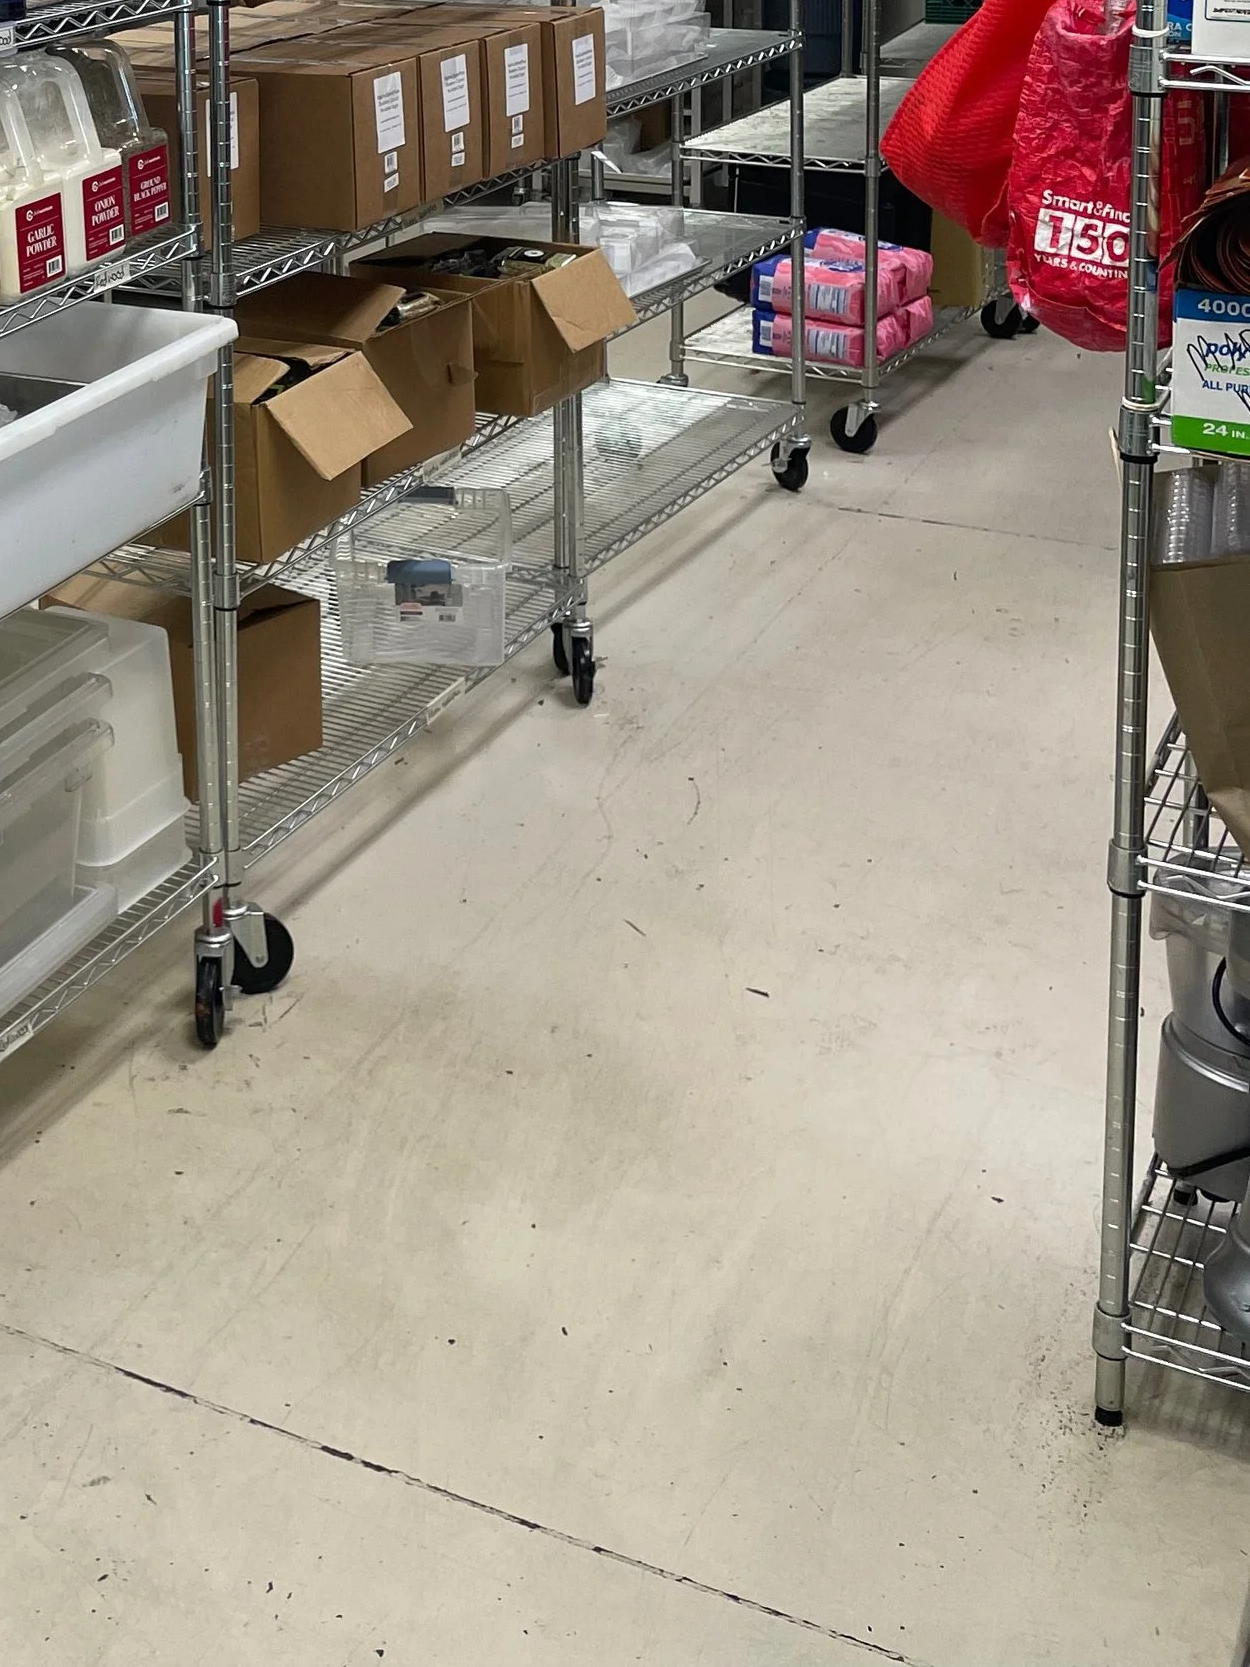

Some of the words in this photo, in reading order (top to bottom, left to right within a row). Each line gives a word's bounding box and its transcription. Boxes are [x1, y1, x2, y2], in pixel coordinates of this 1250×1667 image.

[140, 176, 161, 190] GROUND
[94, 195, 116, 212] ONION
[134, 188, 151, 202] BLACK
[92, 206, 120, 226] POWDER
[27, 224, 55, 243] GARLIC
[1040, 211, 1130, 264] 150
[26, 236, 57, 257] POWDER
[1070, 261, 1078, 270] &
[1079, 263, 1128, 278] COUNTIN
[1206, 364, 1250, 377] PROFES
[1202, 380, 1223, 391] ALL
[1226, 382, 1250, 394] PUR
[1203, 422, 1228, 437] 24
[1232, 430, 1249, 439] IN.
